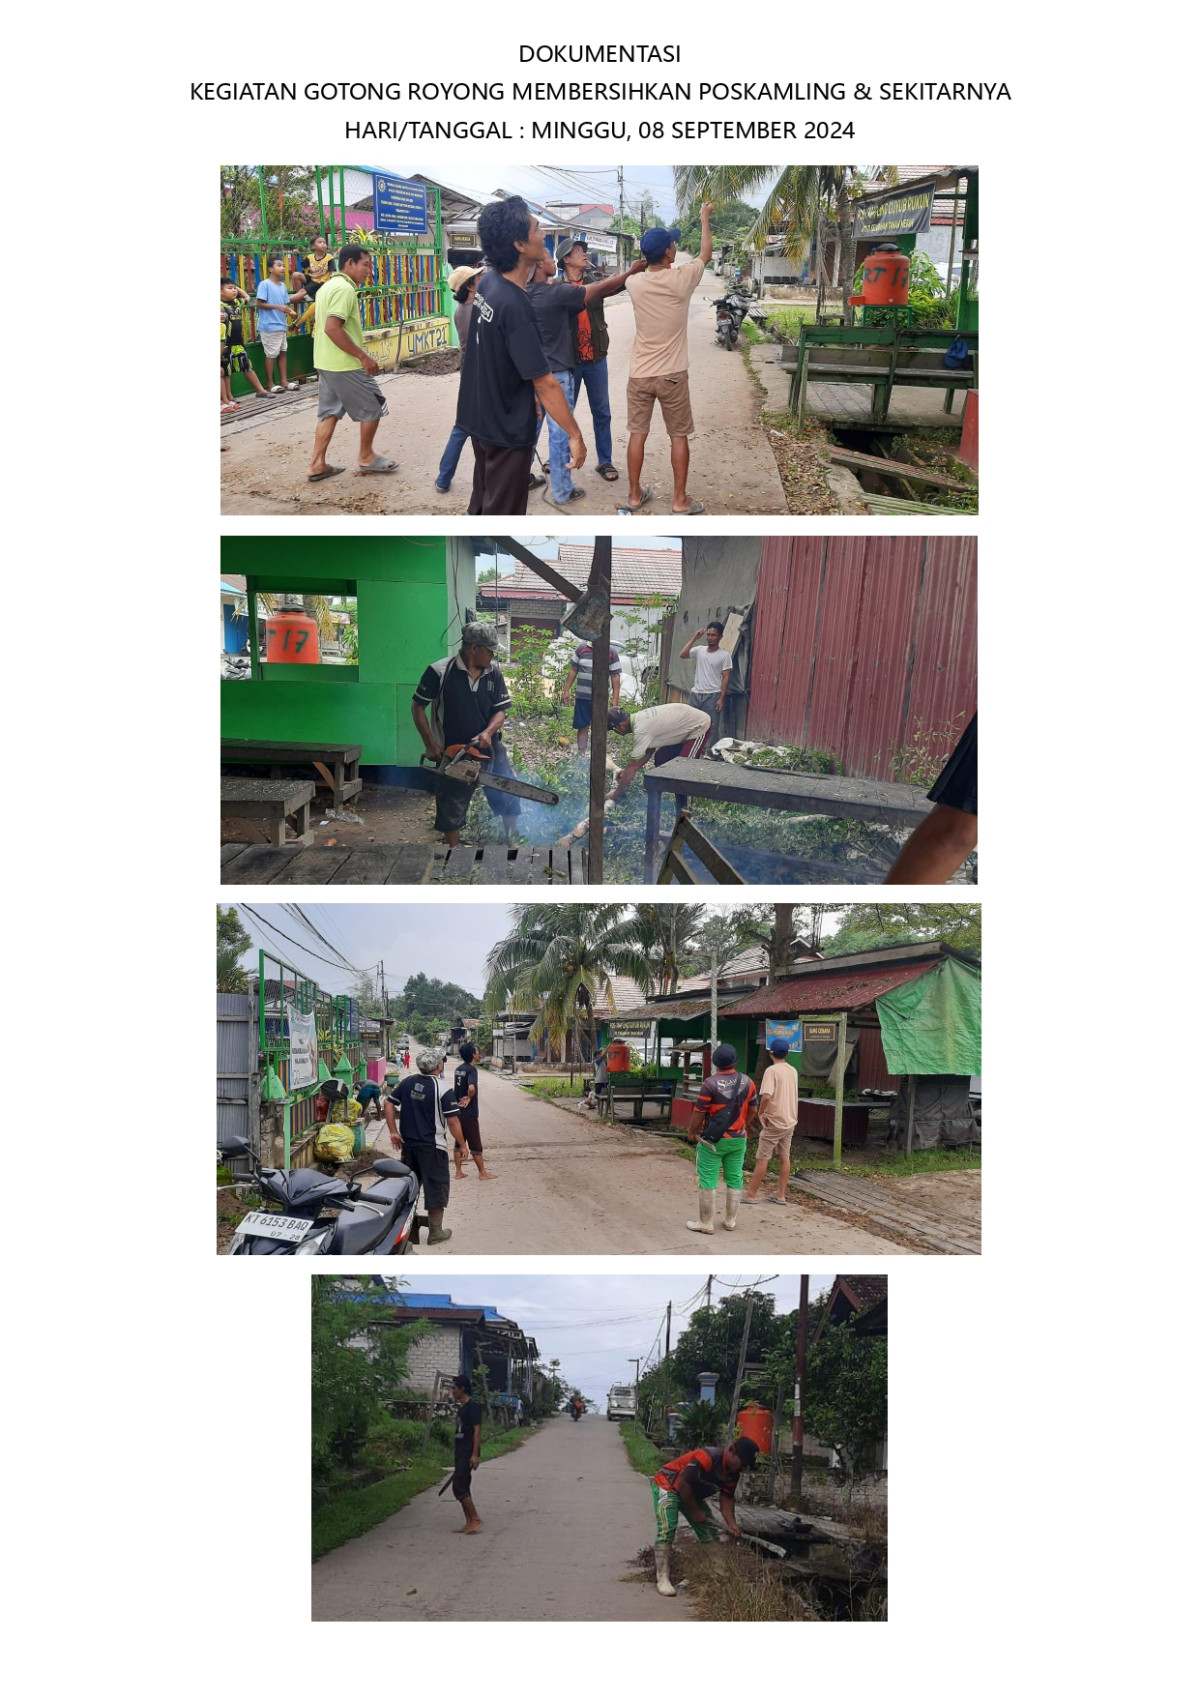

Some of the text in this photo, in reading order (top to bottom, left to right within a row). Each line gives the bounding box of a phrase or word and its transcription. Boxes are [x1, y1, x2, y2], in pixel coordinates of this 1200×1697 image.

[519, 44, 681, 63] DOKUMENTASI
[191, 82, 1012, 101] KEGIATAN GOTONG ROYONG MEMBERSIHKAN POSKAMLING & SEKITARNYA
[345, 121, 856, 142] HARI/TANGGAL : MINGGU, 08 SEPTEMBER 2024
[864, 267, 909, 289] RT 17
[283, 630, 308, 652] 17
[245, 1213, 309, 1231] KT 6153 BAQ
